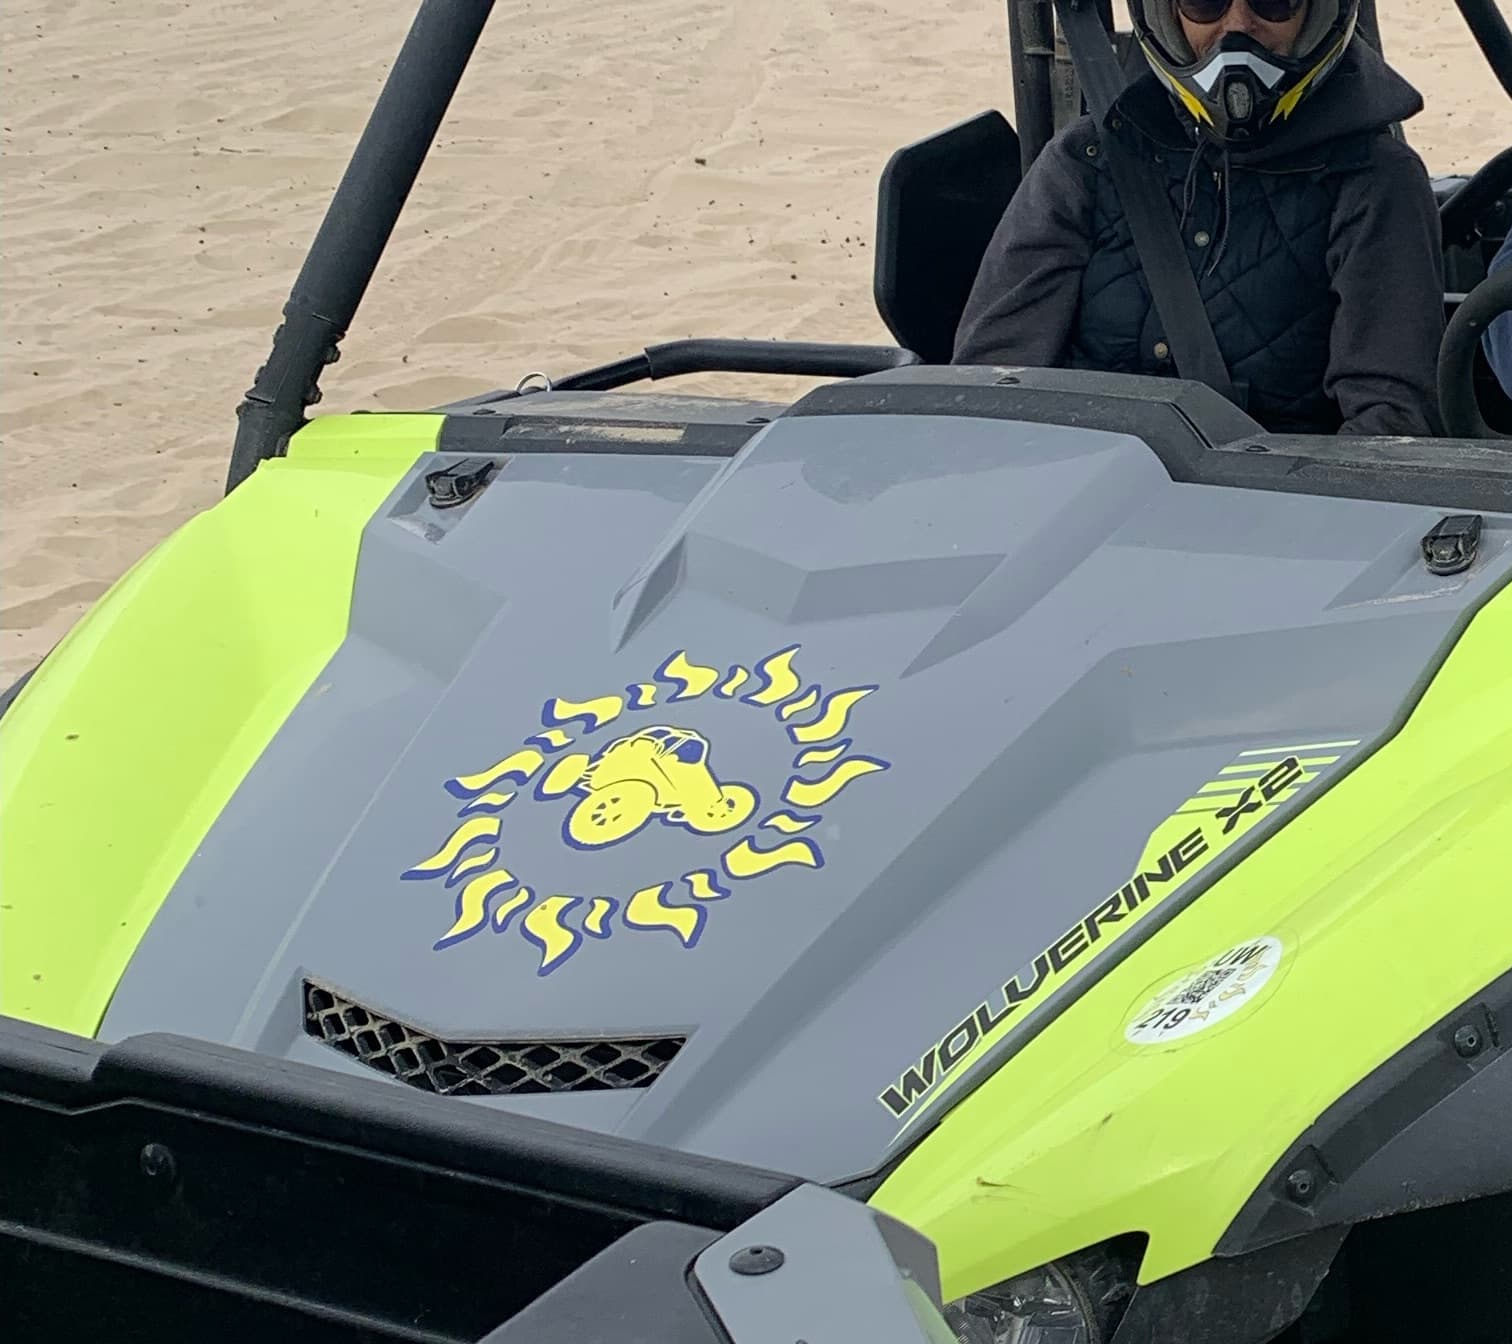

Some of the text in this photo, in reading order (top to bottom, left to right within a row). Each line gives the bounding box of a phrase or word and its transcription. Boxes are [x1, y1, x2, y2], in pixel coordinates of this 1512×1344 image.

[879, 755, 1304, 1117] WOLVERINE X2
[1134, 1007, 1191, 1030] 219
